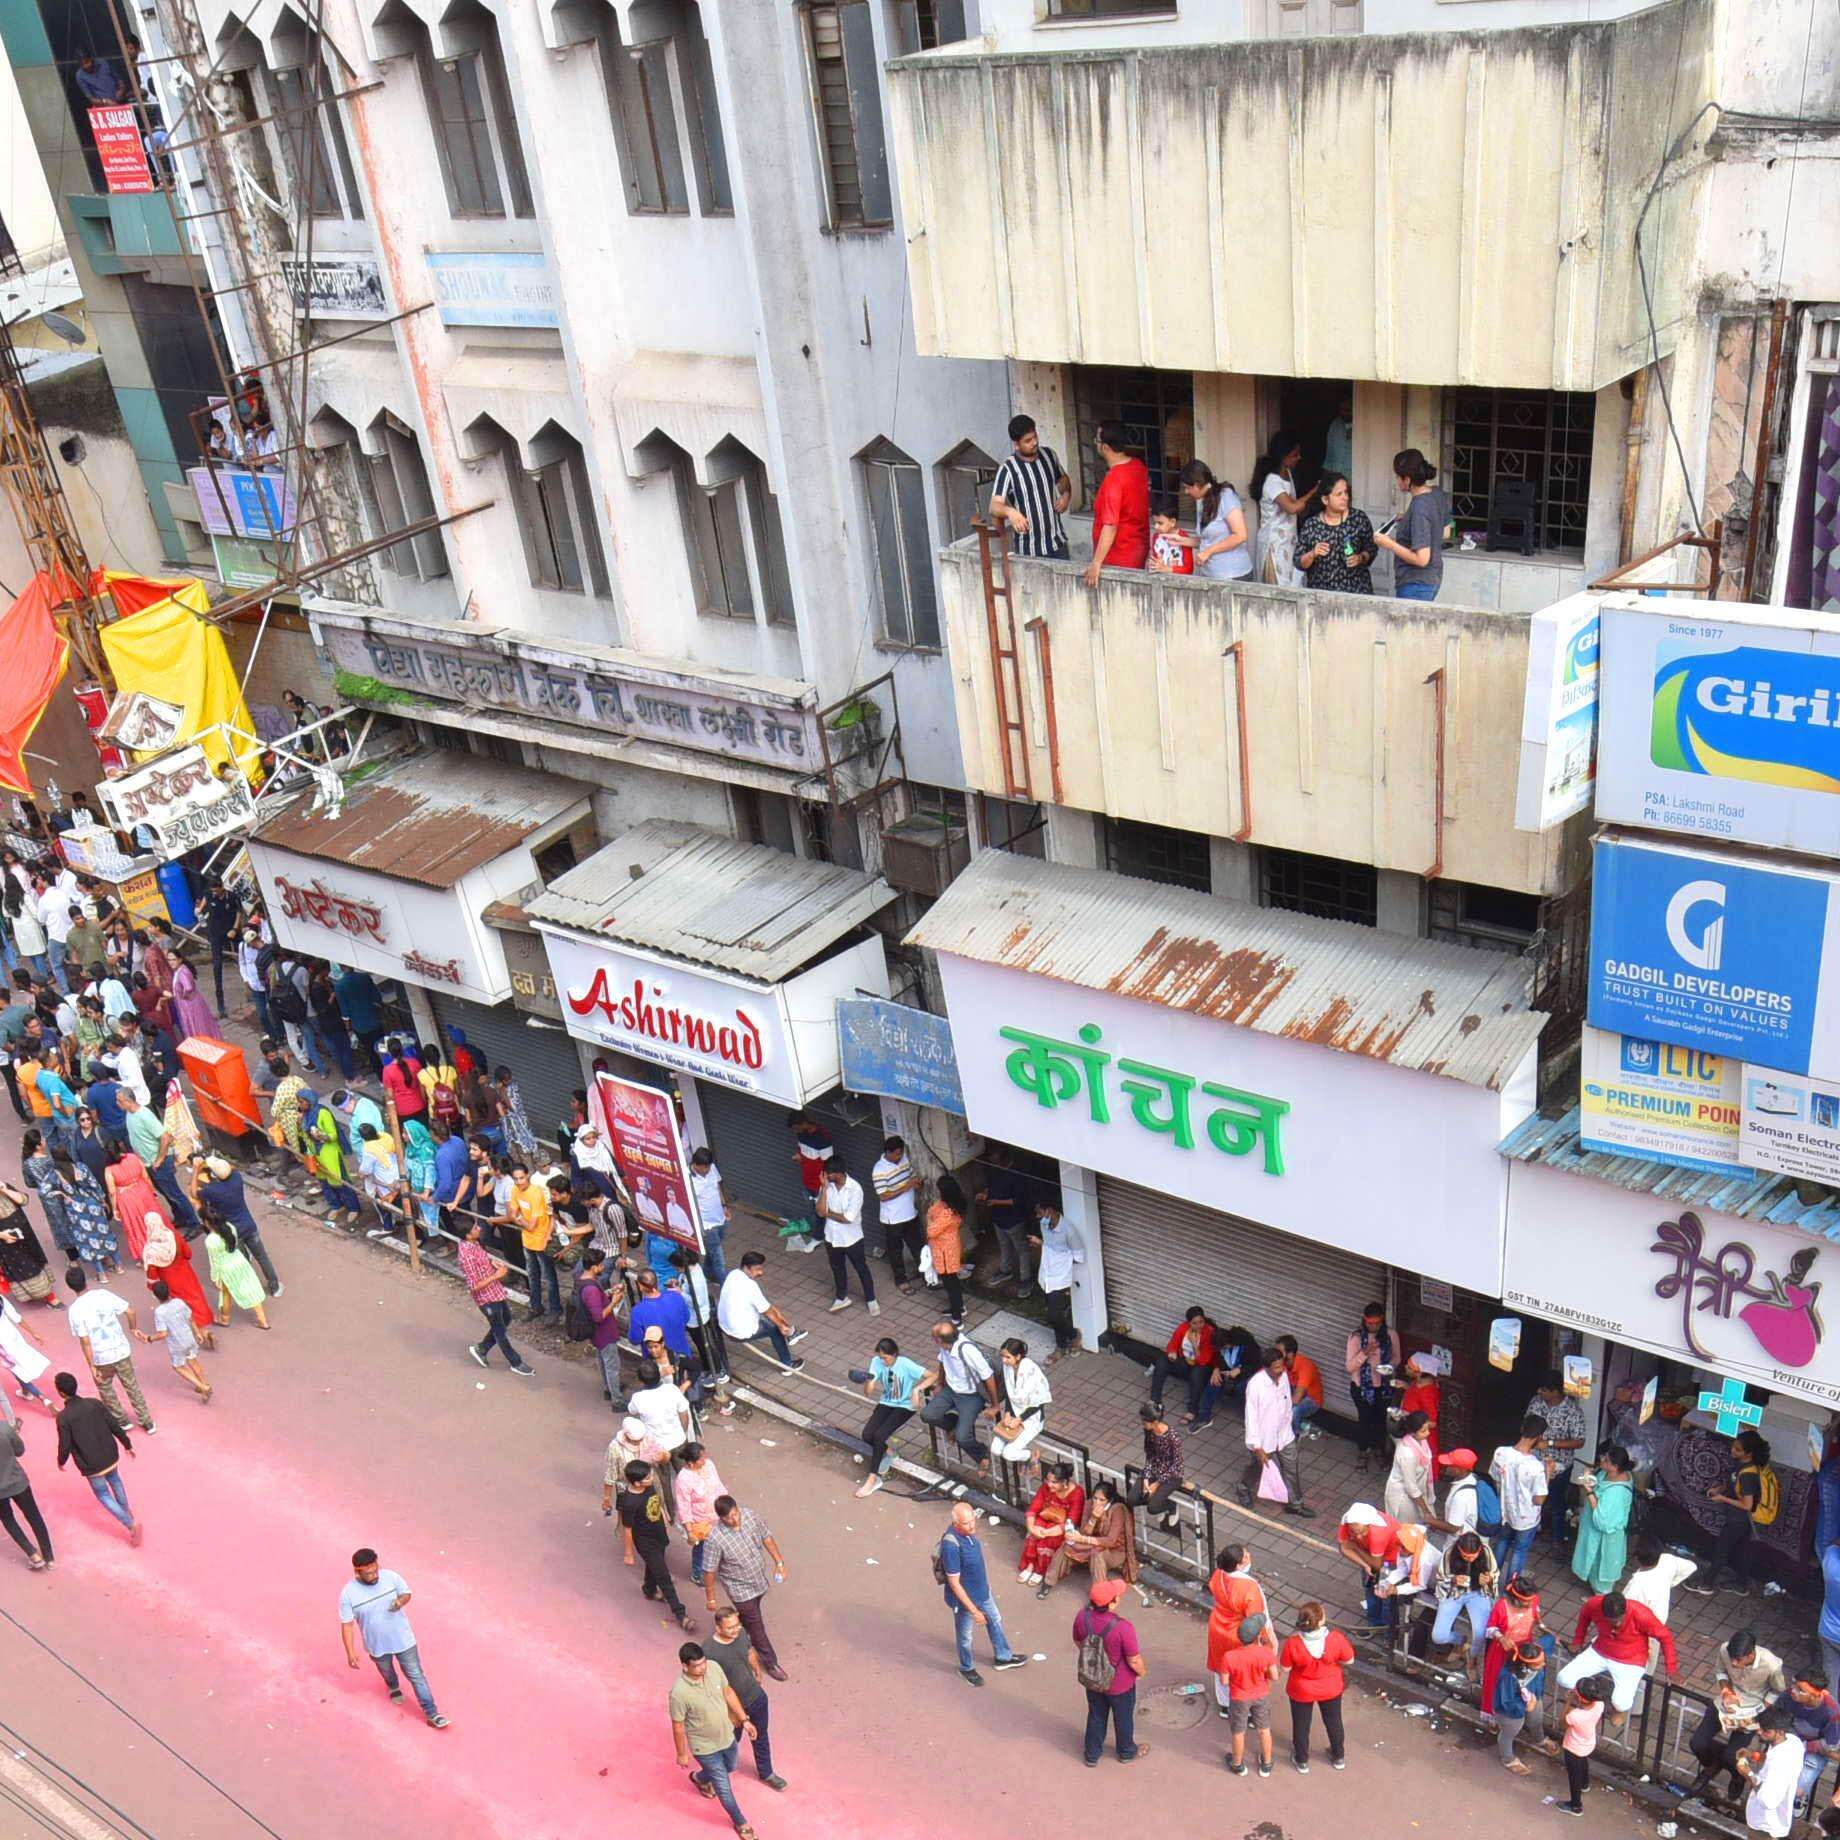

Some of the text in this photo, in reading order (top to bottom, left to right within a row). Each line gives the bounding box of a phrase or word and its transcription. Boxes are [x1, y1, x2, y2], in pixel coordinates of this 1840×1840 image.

[1668, 623, 1724, 640] Since 1977
[1643, 807, 1661, 820] Ph:
[1644, 791, 1745, 818] PSA: Lakshmi Road
[1604, 959, 1793, 1012] GADGIL DEVELOPERS
[567, 967, 763, 1070] Ashirwad
[1603, 980, 1650, 1000] TRUST
[1655, 991, 1697, 1009] BUILT
[1703, 1001, 1724, 1016] ON
[1729, 1008, 1790, 1030] VALUES
[1666, 1044, 1715, 1081] LIC
[998, 1022, 1291, 1176] कांचन
[1606, 1088, 1691, 1118] PREMIUM
[1747, 1120, 1795, 1142] Soman
[1507, 1290, 1525, 1303] GST
[1525, 1293, 1542, 1307] TIN
[1771, 1368, 1826, 1394] Venture
